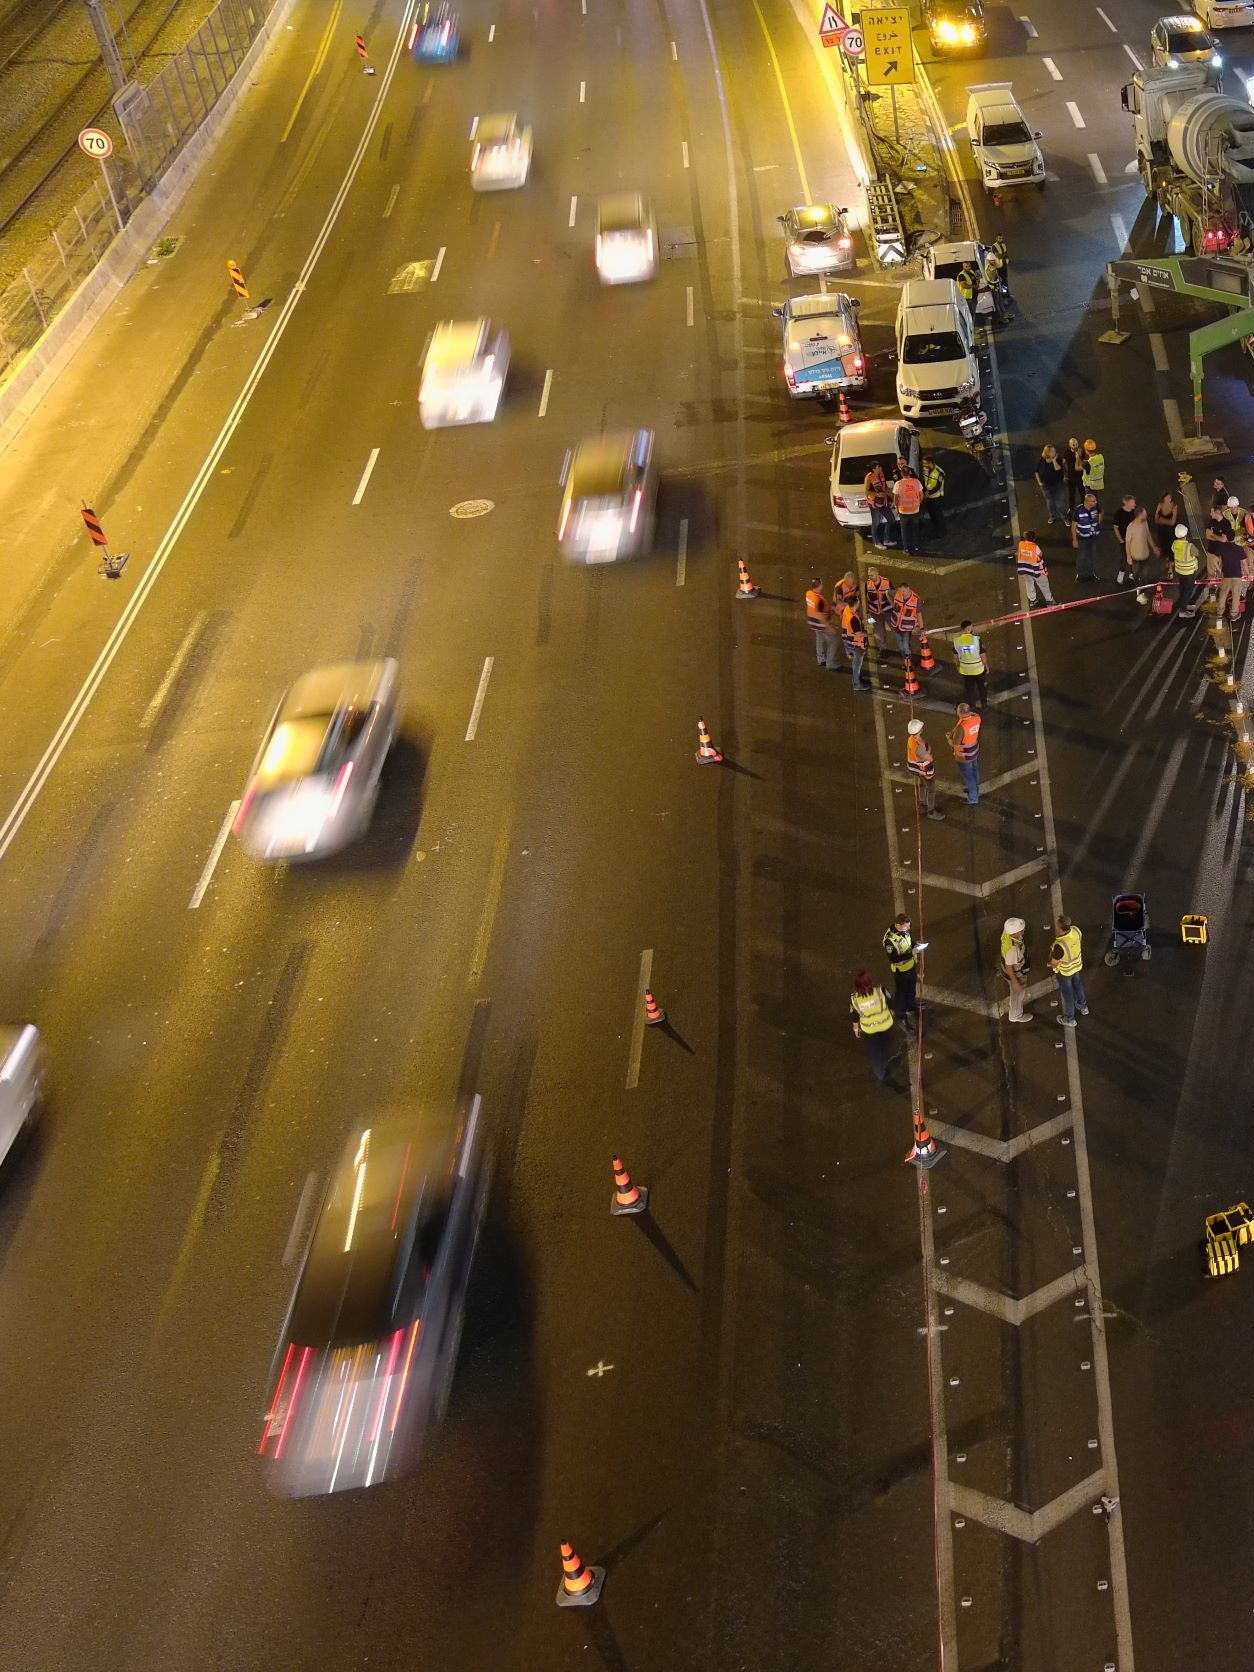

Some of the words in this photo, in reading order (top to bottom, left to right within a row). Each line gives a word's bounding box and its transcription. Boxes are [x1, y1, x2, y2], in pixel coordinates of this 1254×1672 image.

[868, 15, 903, 26] יציאה
[876, 30, 899, 41] خروج
[847, 37, 862, 48] 70
[875, 46, 902, 55] EXIT
[85, 138, 105, 149] 70
